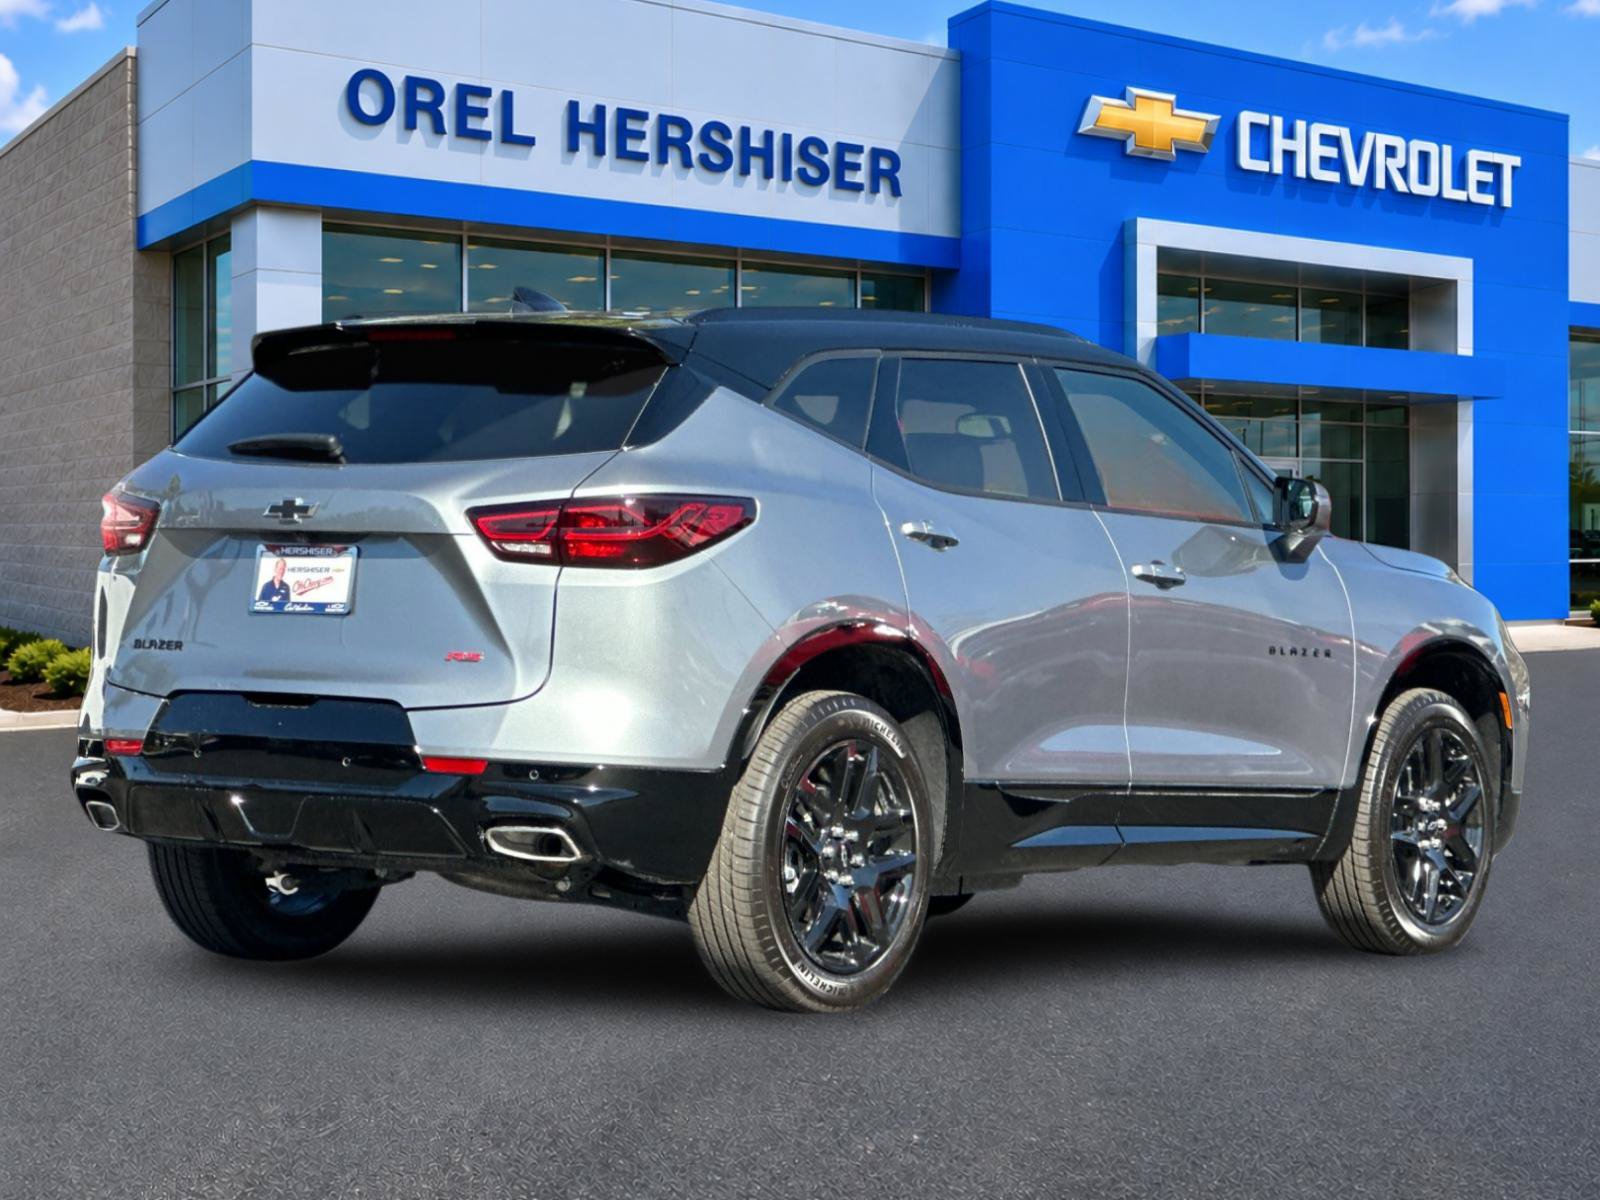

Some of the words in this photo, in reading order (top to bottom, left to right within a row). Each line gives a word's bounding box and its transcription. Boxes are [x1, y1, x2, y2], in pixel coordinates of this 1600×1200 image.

[347, 68, 536, 146] OREL
[566, 99, 903, 197] HERSHISER
[1238, 110, 1521, 207] CHEVROLET
[281, 546, 333, 555] HERSHISER
[133, 638, 184, 651] BLAZER
[1268, 645, 1332, 658] BLAZER
[798, 963, 848, 996] MICHELIN
